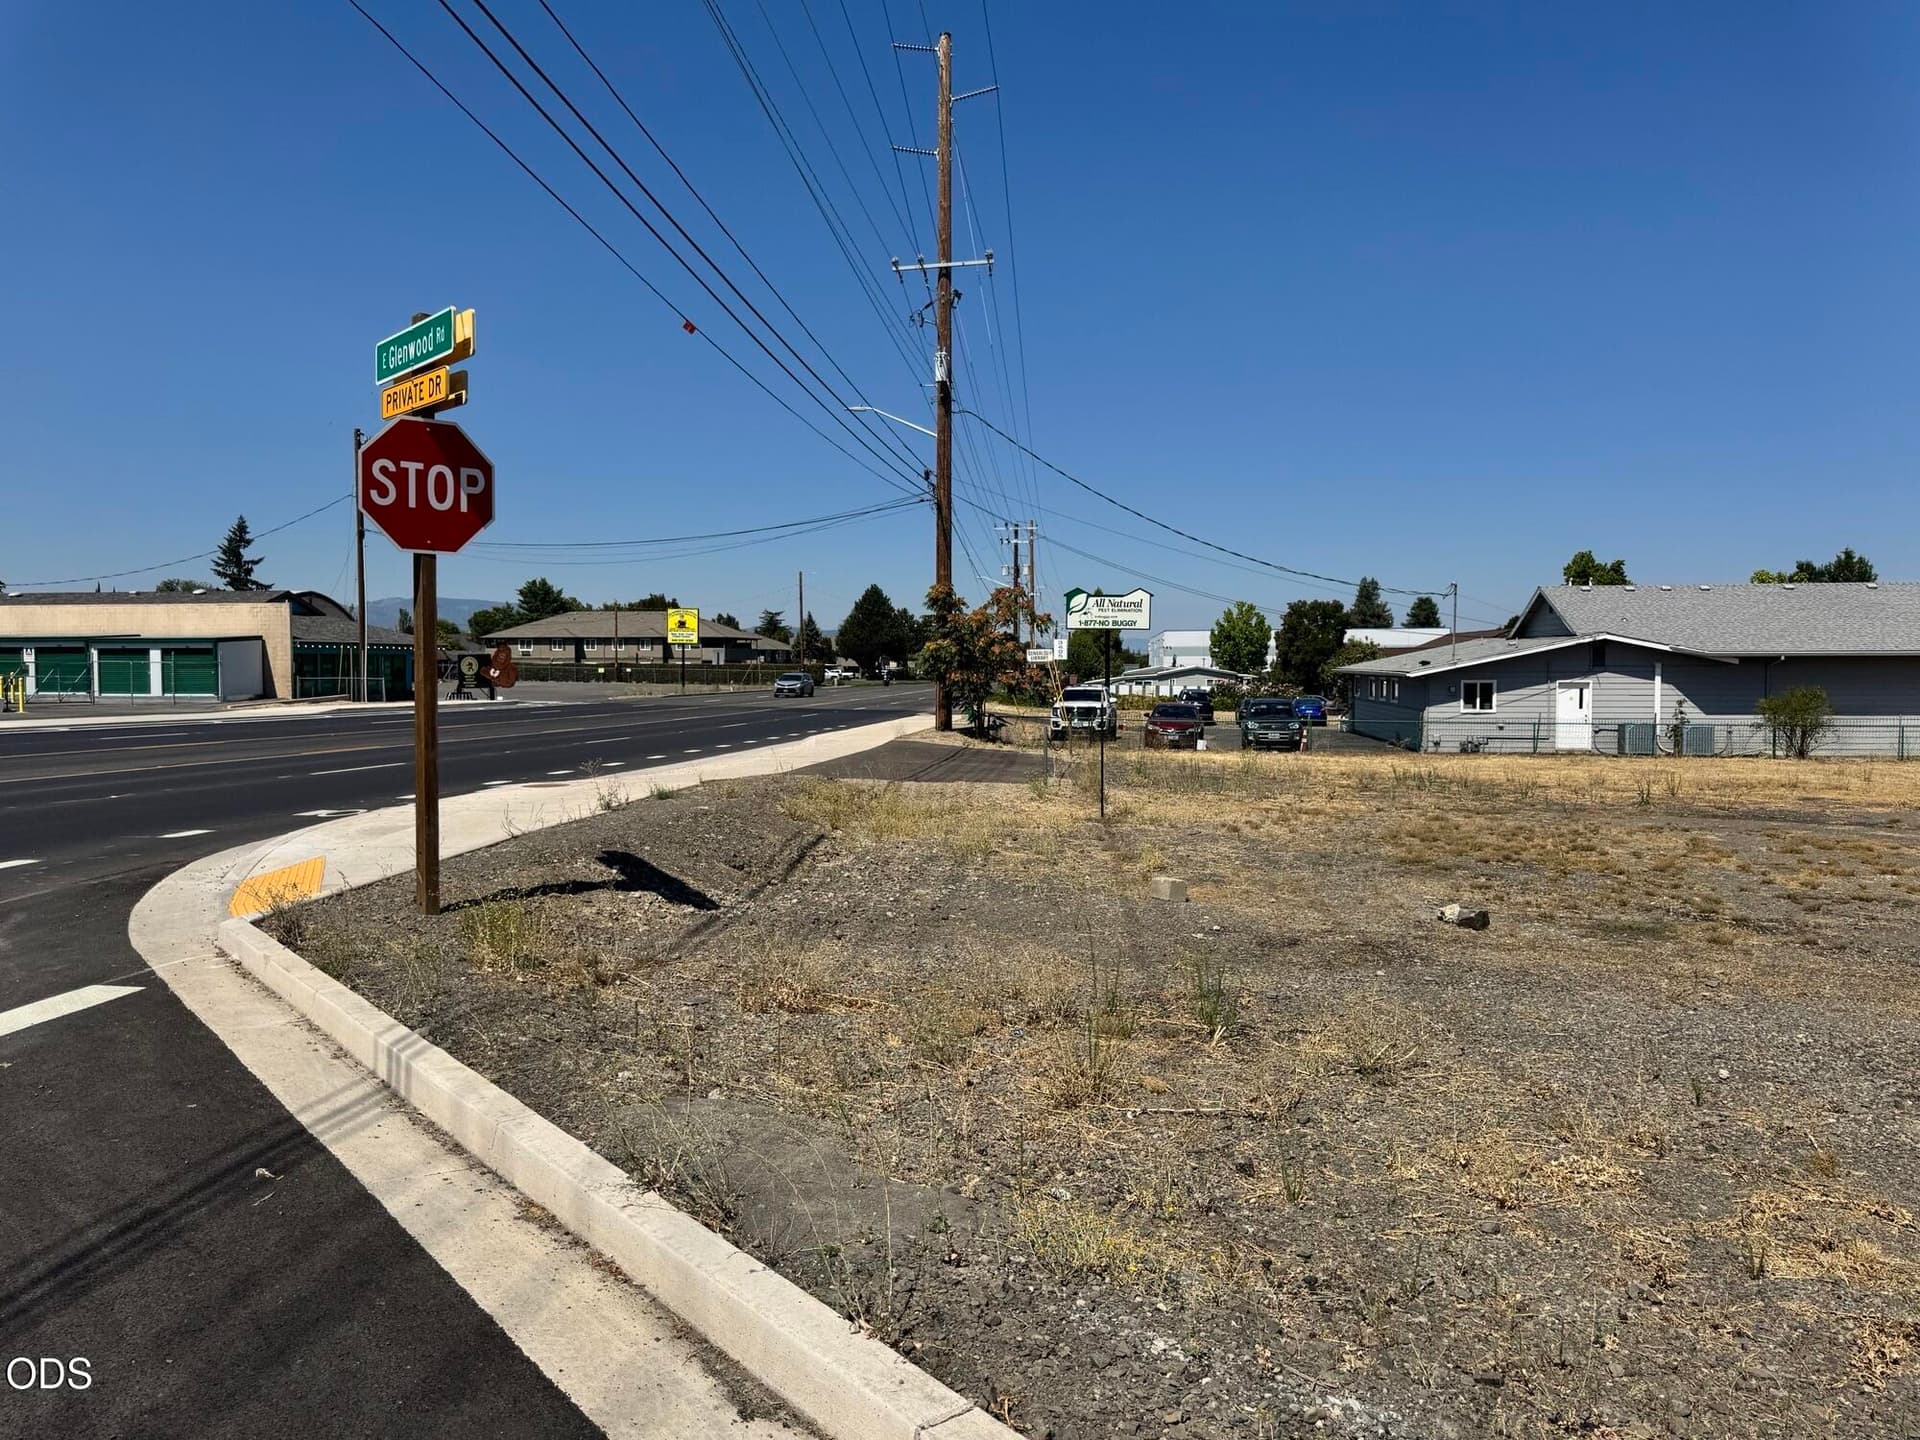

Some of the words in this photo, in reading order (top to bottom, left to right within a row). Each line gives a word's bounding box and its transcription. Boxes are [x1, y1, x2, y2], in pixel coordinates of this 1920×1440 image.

[382, 352, 387, 369] E
[388, 328, 434, 369] Glenwood
[436, 327, 445, 345] Rd
[386, 380, 425, 413] PRIVATE
[428, 375, 442, 398] DR
[369, 458, 486, 513] STOP
[1092, 598, 1106, 608] All
[1107, 598, 1143, 608] Natural
